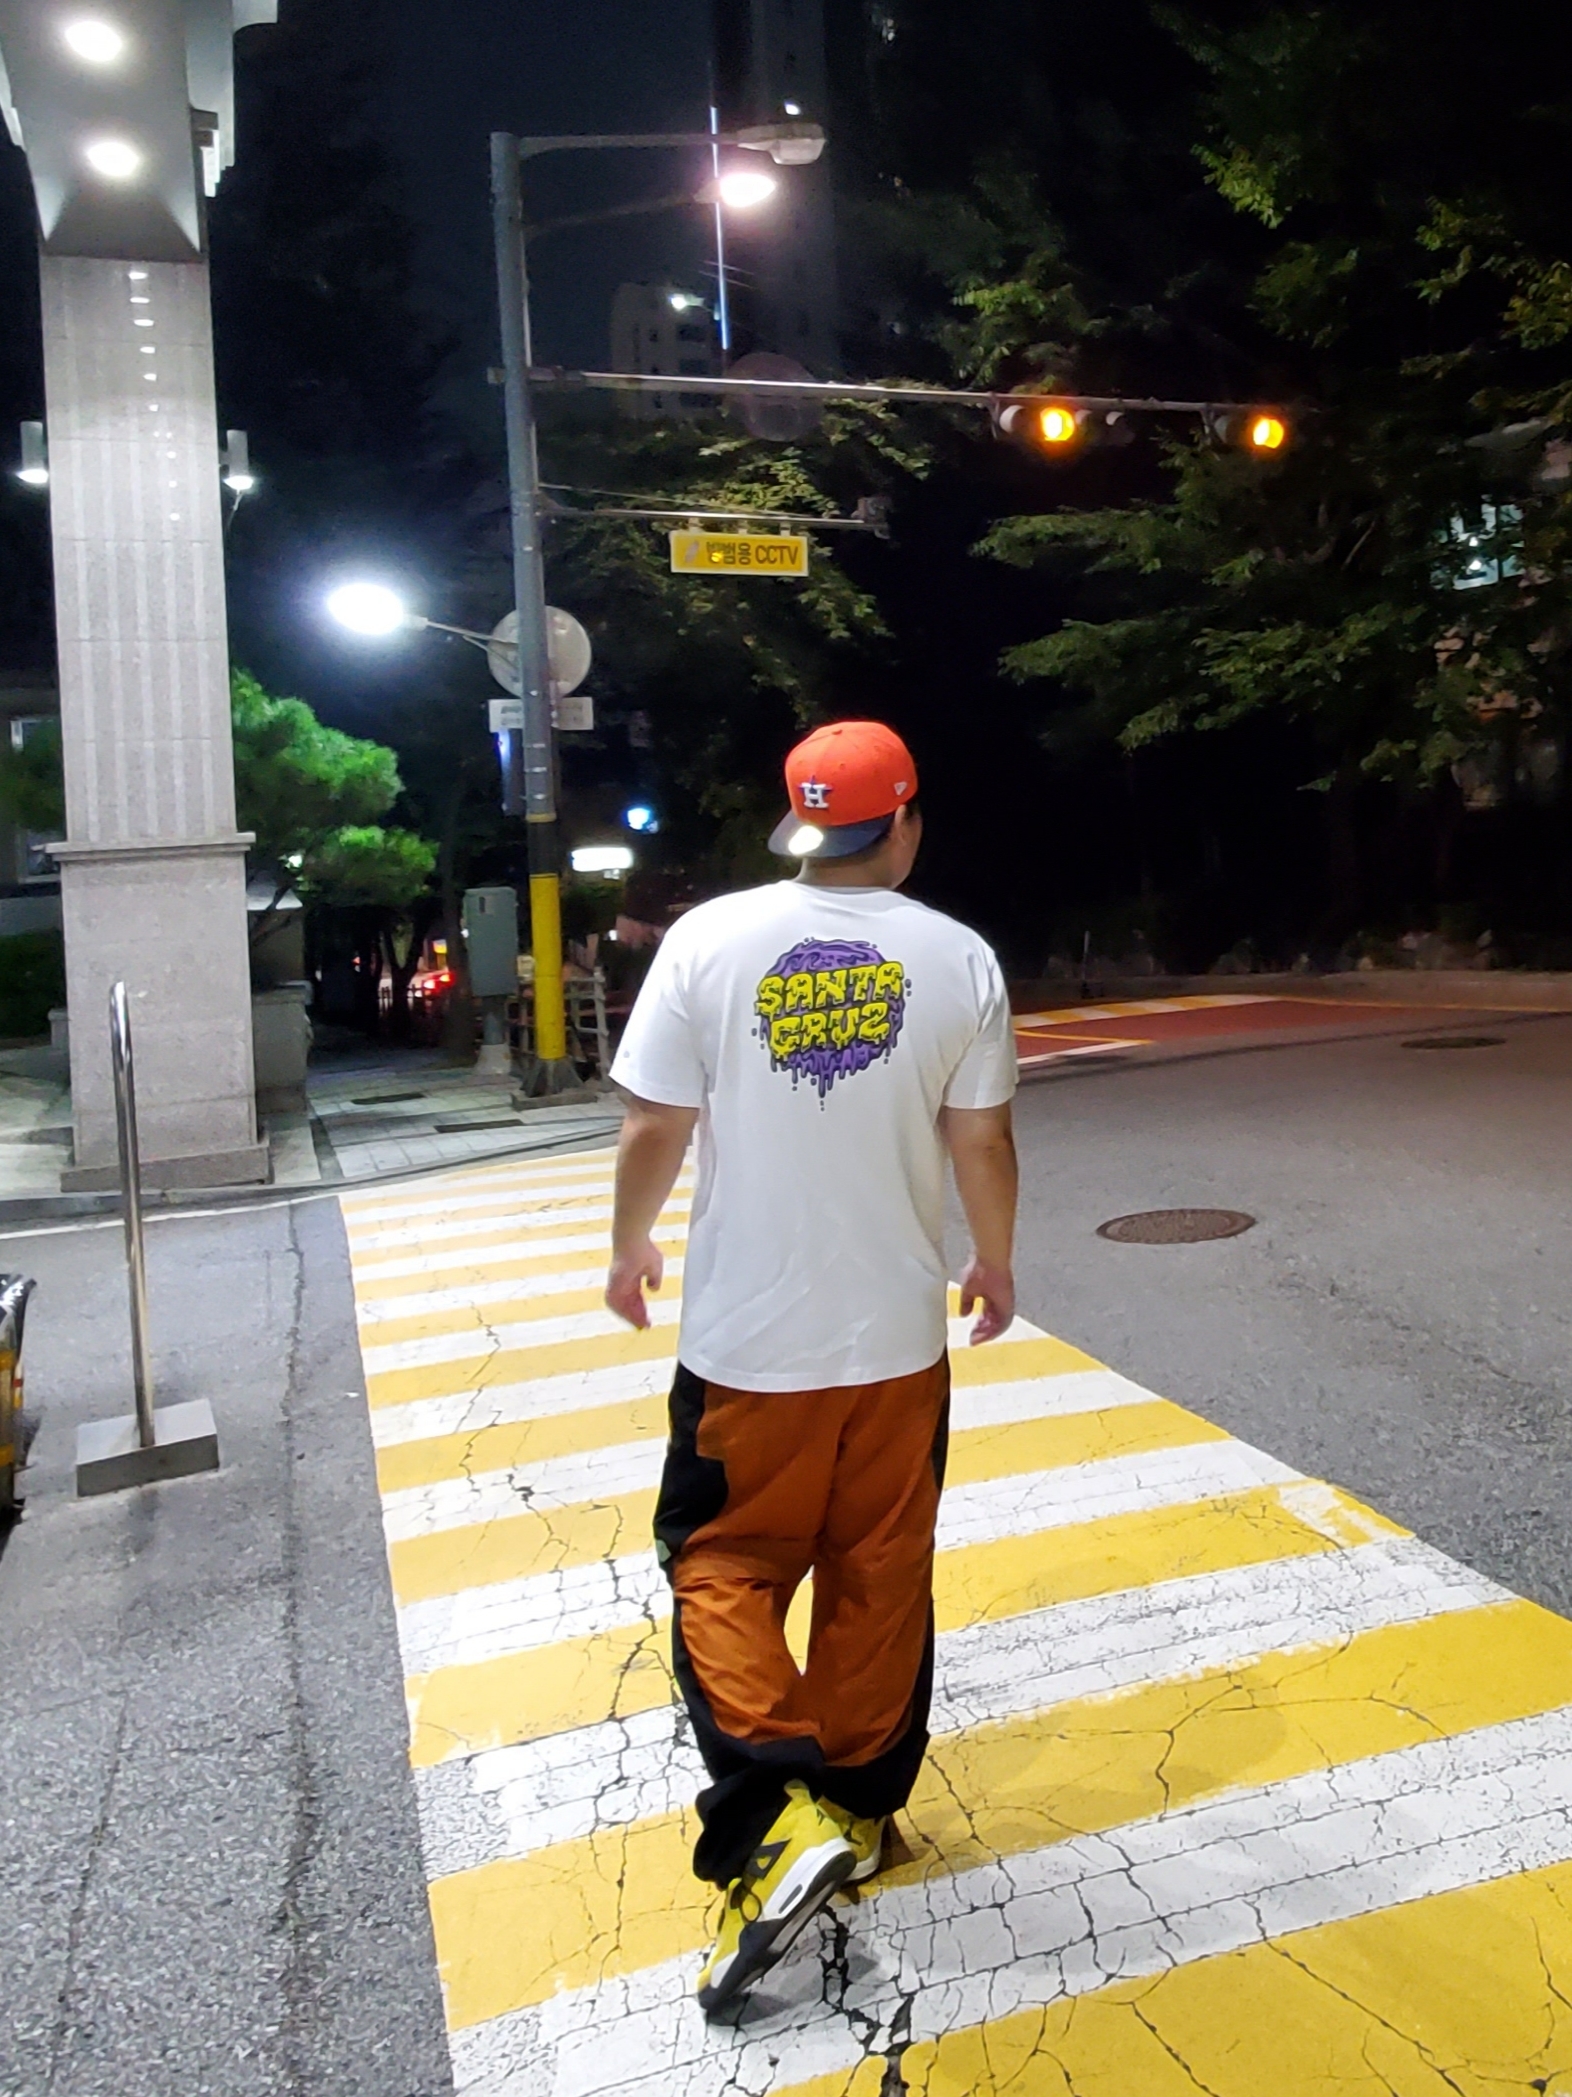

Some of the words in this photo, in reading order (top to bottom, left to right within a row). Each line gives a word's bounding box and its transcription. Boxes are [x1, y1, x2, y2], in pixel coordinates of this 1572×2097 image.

[755, 545, 798, 565] CCTV
[754, 961, 903, 1019] SANTA
[770, 1001, 890, 1060] CRUZ
